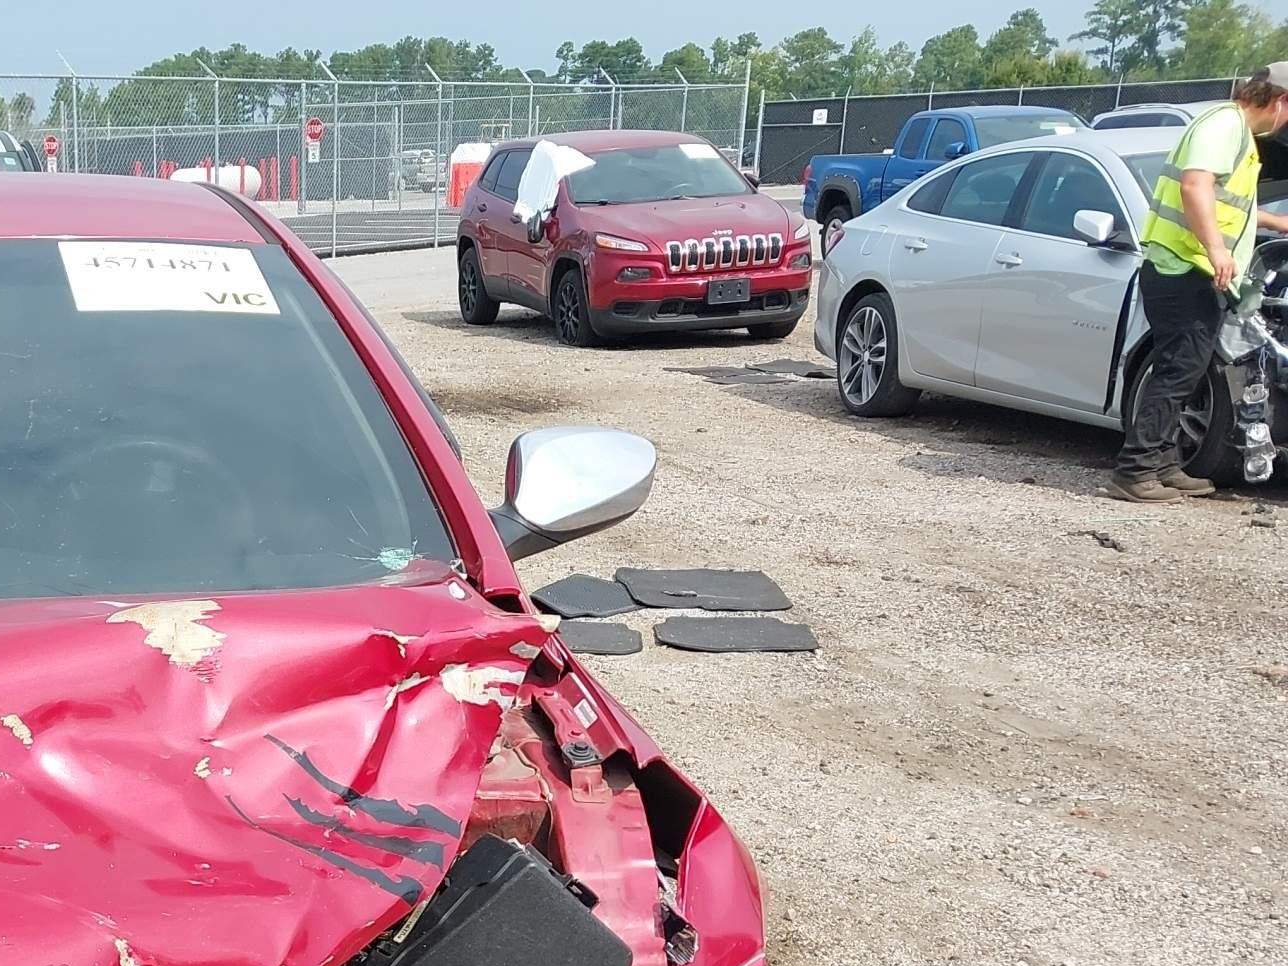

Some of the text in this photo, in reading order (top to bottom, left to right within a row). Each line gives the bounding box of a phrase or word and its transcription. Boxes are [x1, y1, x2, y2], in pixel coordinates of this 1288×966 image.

[308, 125, 322, 134] STOP
[84, 256, 231, 272] 45714871
[203, 290, 268, 307] VIC
